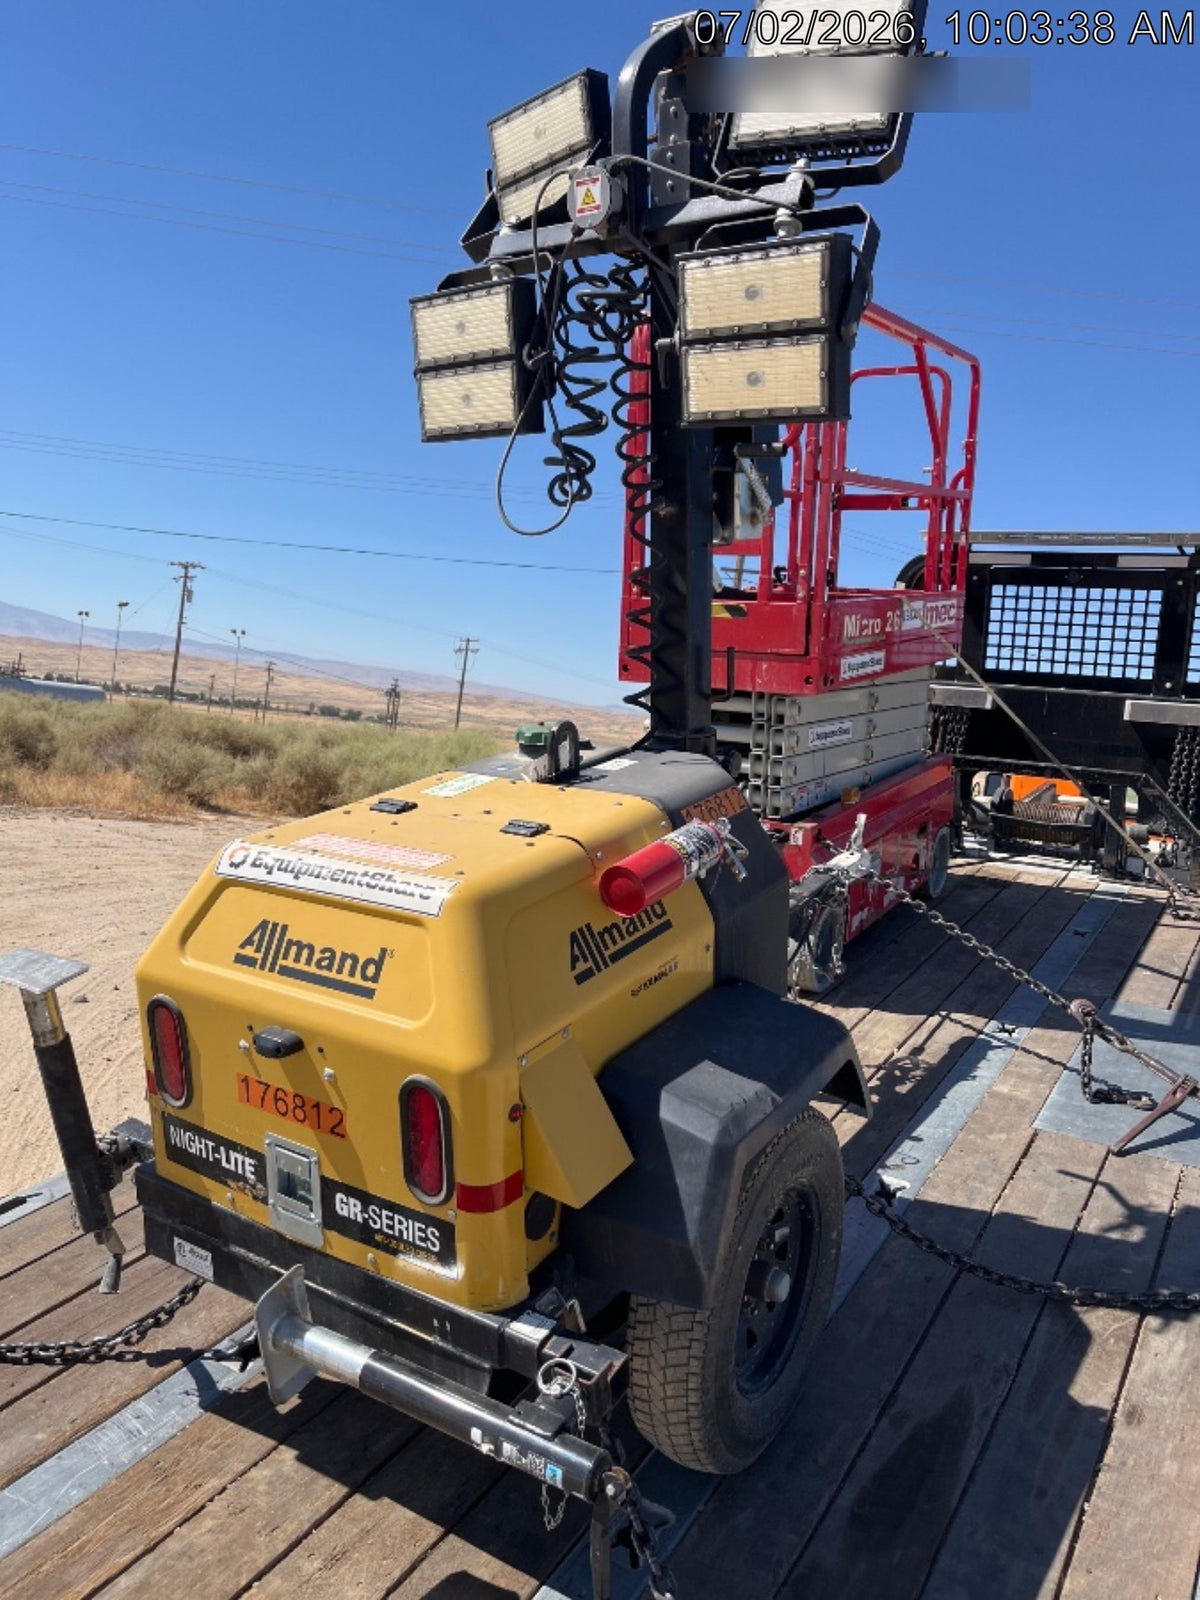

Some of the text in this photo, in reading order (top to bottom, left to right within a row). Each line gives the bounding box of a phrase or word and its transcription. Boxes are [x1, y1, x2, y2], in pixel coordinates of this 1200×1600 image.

[843, 614, 881, 639] Micro
[885, 610, 900, 633] 26
[238, 918, 388, 984] Allmand
[240, 1075, 346, 1138] 176812
[169, 1124, 257, 1181] NIGHT-LITE
[335, 1192, 440, 1252] GR-SERIES
